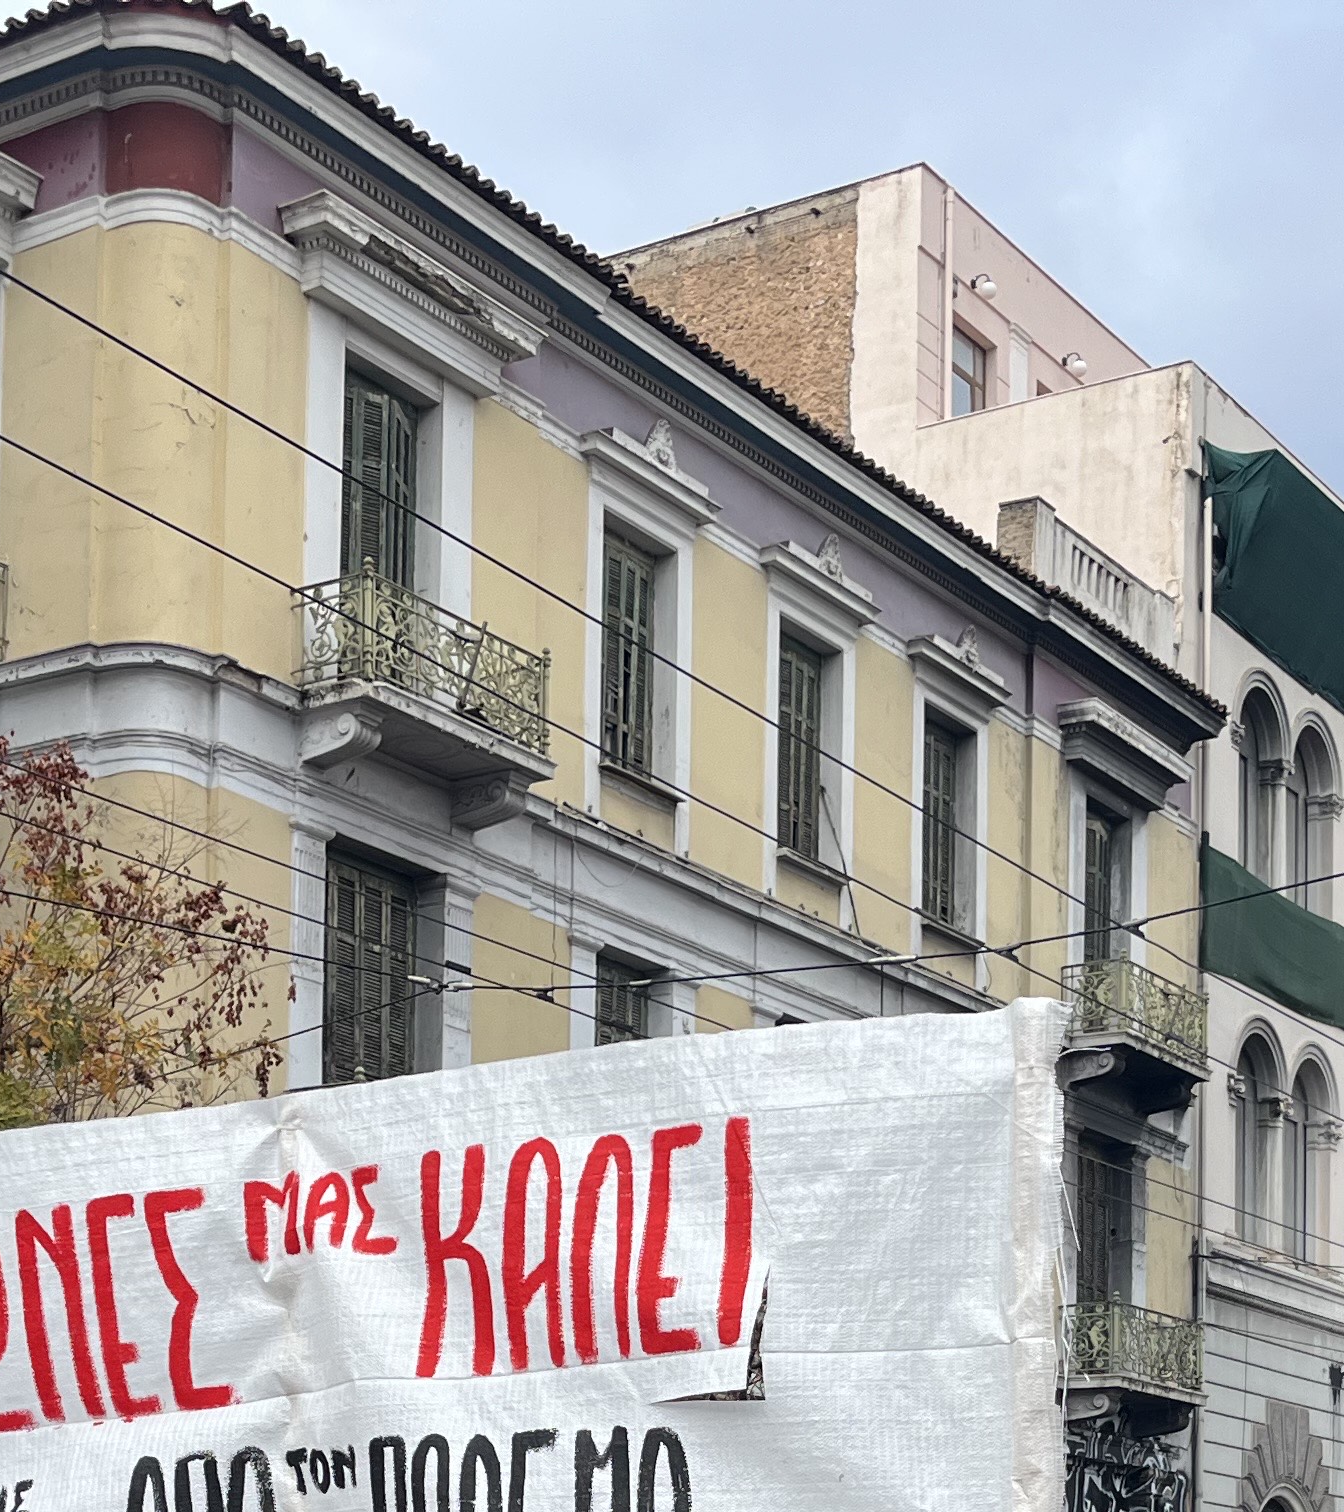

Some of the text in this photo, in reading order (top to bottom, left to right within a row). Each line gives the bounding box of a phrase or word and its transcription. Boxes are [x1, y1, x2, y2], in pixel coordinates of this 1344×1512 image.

[243, 1161, 400, 1264] ΜΑΣ
[415, 1115, 753, 1379] ΚΑΛΕΙ
[287, 1444, 357, 1495] ΤΟΝ
